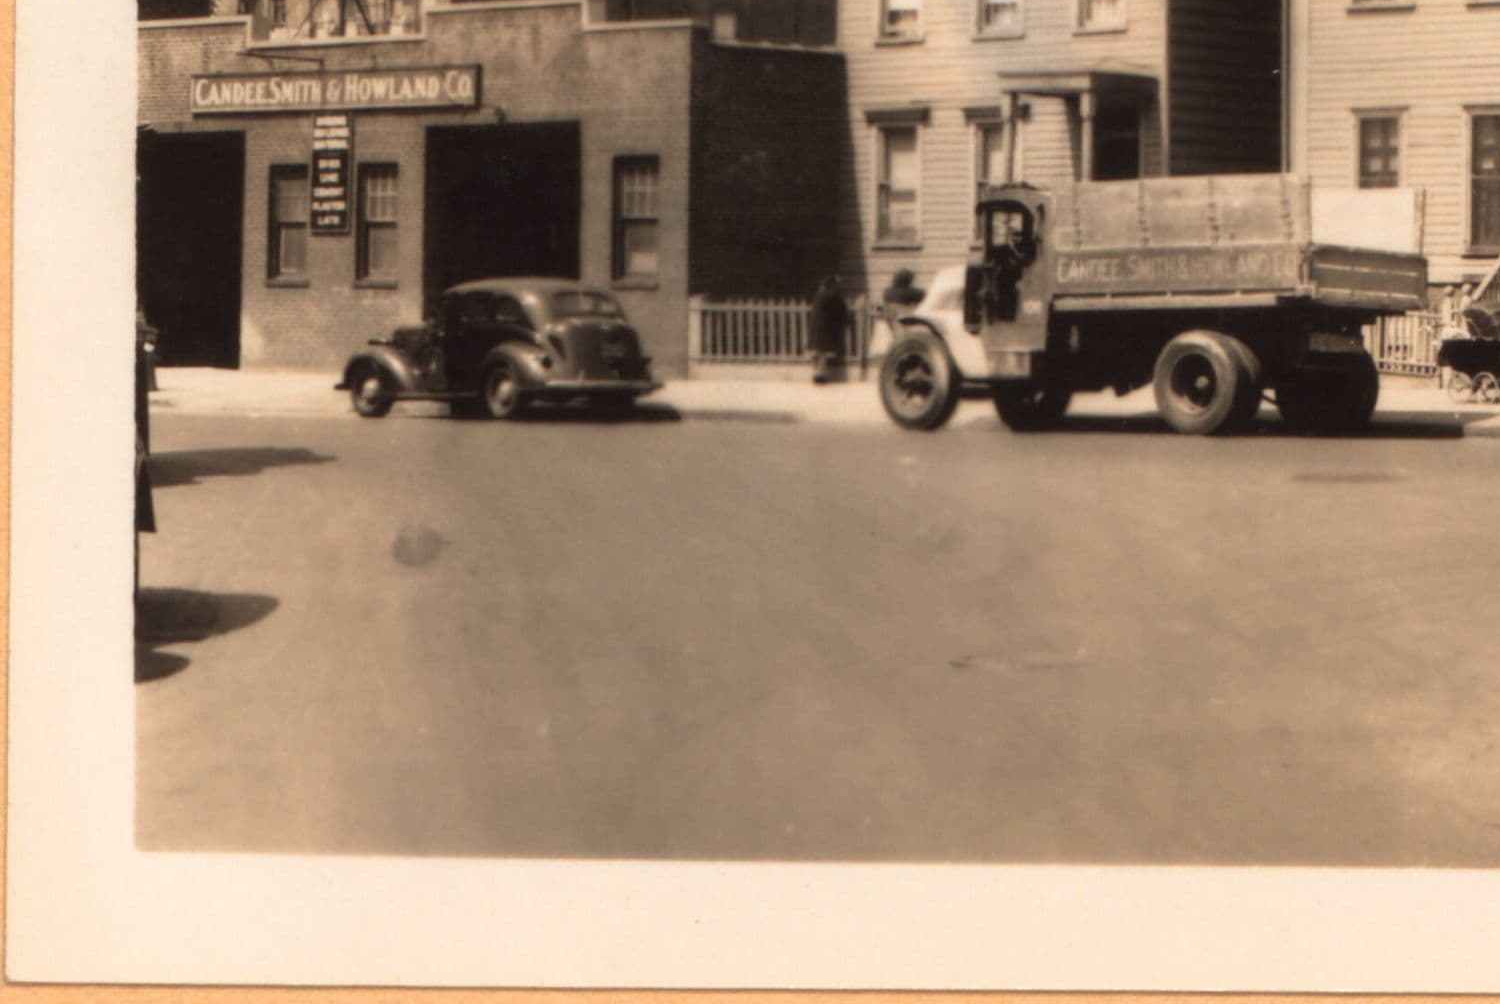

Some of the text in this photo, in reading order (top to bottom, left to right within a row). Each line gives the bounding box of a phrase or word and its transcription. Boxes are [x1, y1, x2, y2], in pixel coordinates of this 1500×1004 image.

[195, 78, 267, 106] CANDEE
[269, 76, 322, 104] SMITH
[326, 77, 341, 102] &
[344, 73, 441, 102] HOWLAND
[1057, 256, 1121, 283] CANDEE
